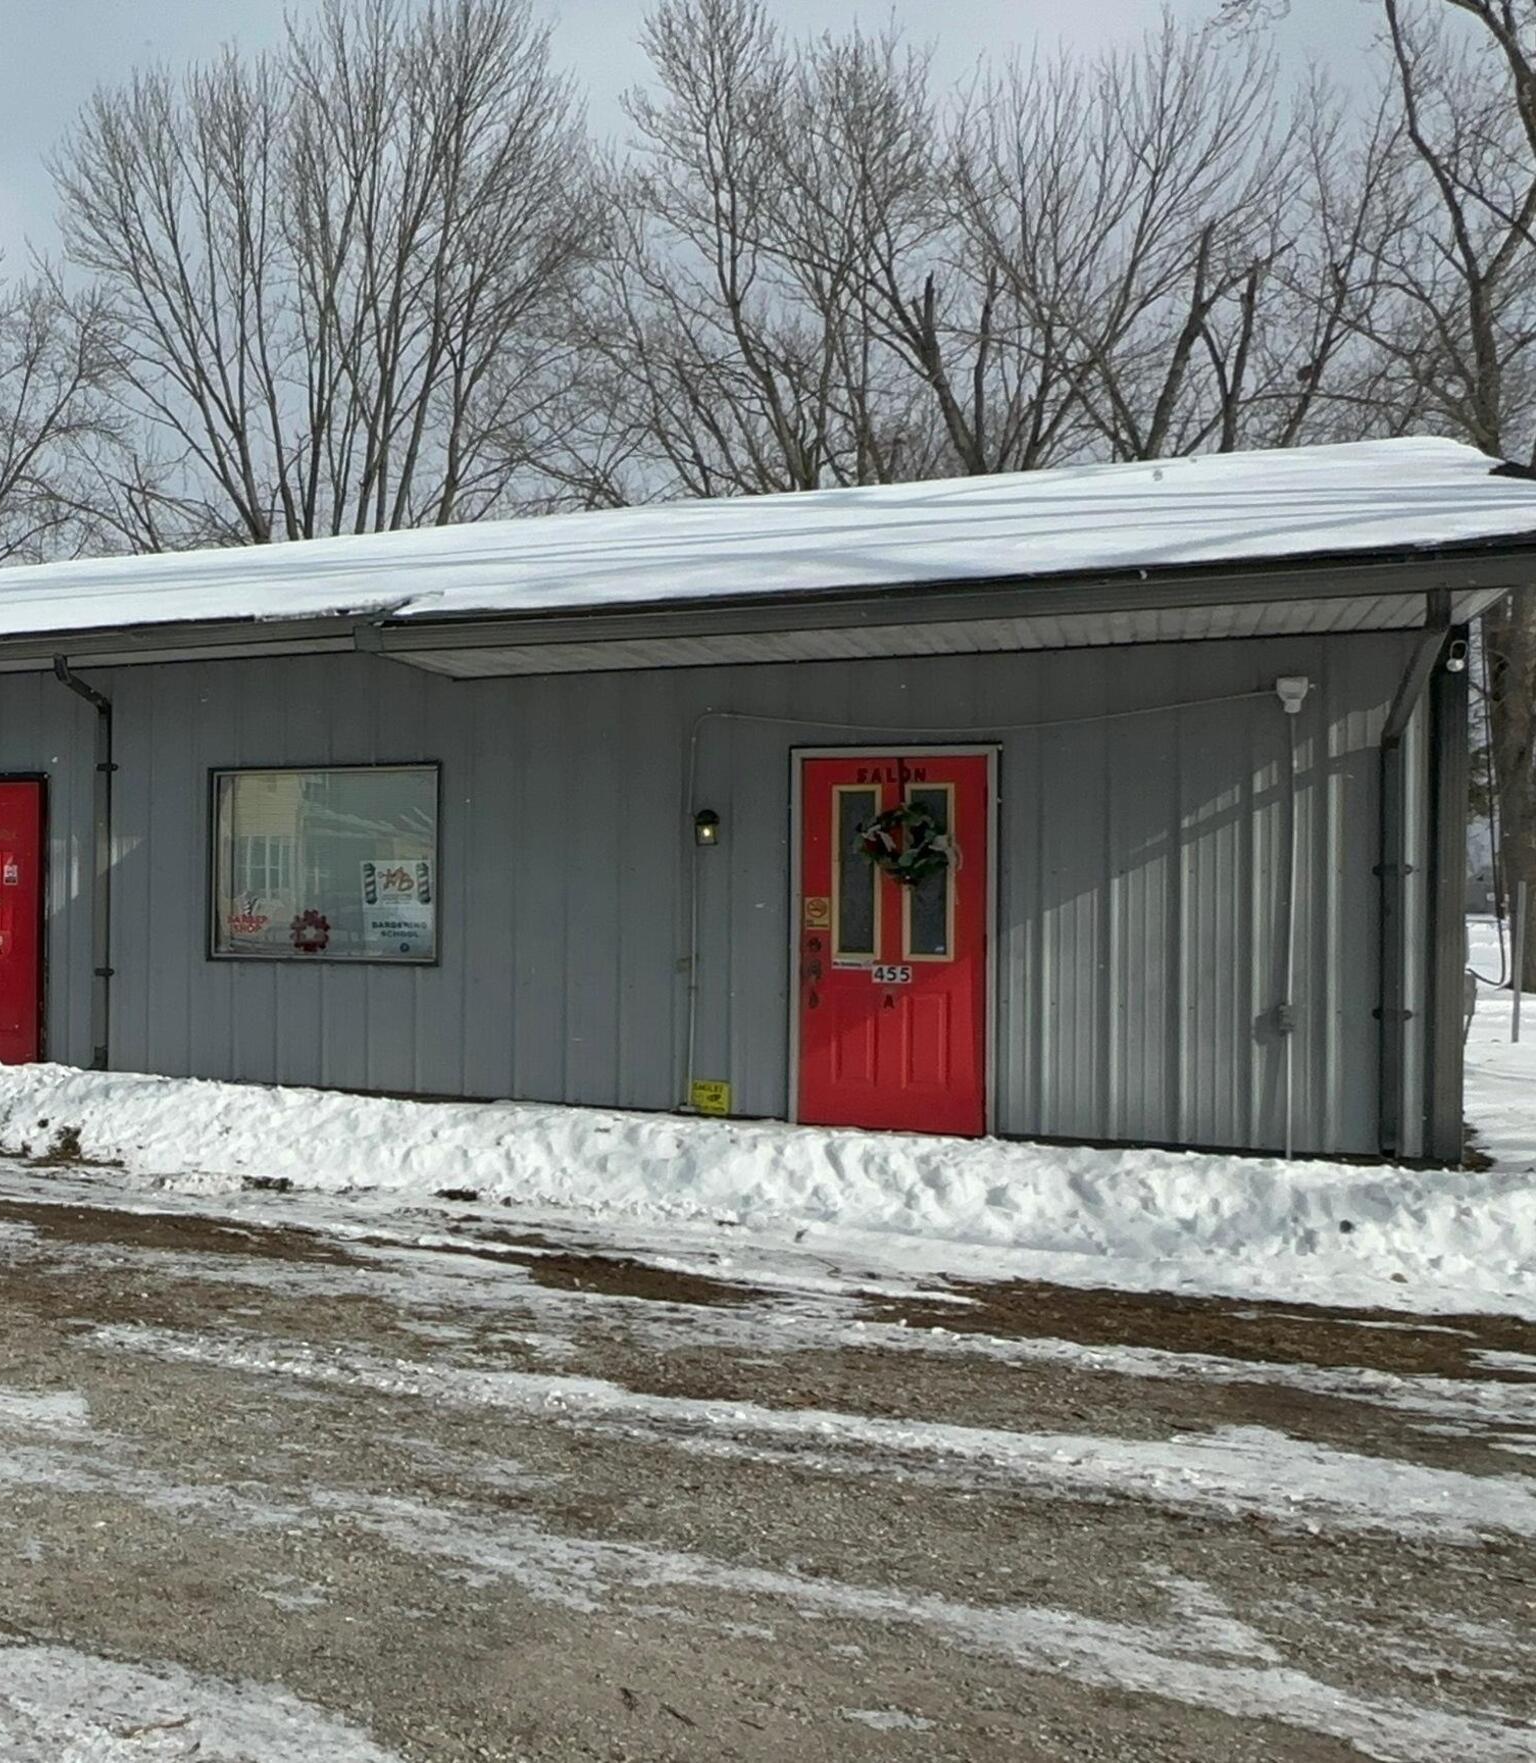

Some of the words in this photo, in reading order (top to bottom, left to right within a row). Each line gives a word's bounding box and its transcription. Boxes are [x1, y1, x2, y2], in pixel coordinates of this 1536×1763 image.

[856, 766, 927, 784] SALON
[874, 966, 911, 982] 455
[883, 993, 895, 1010] A
